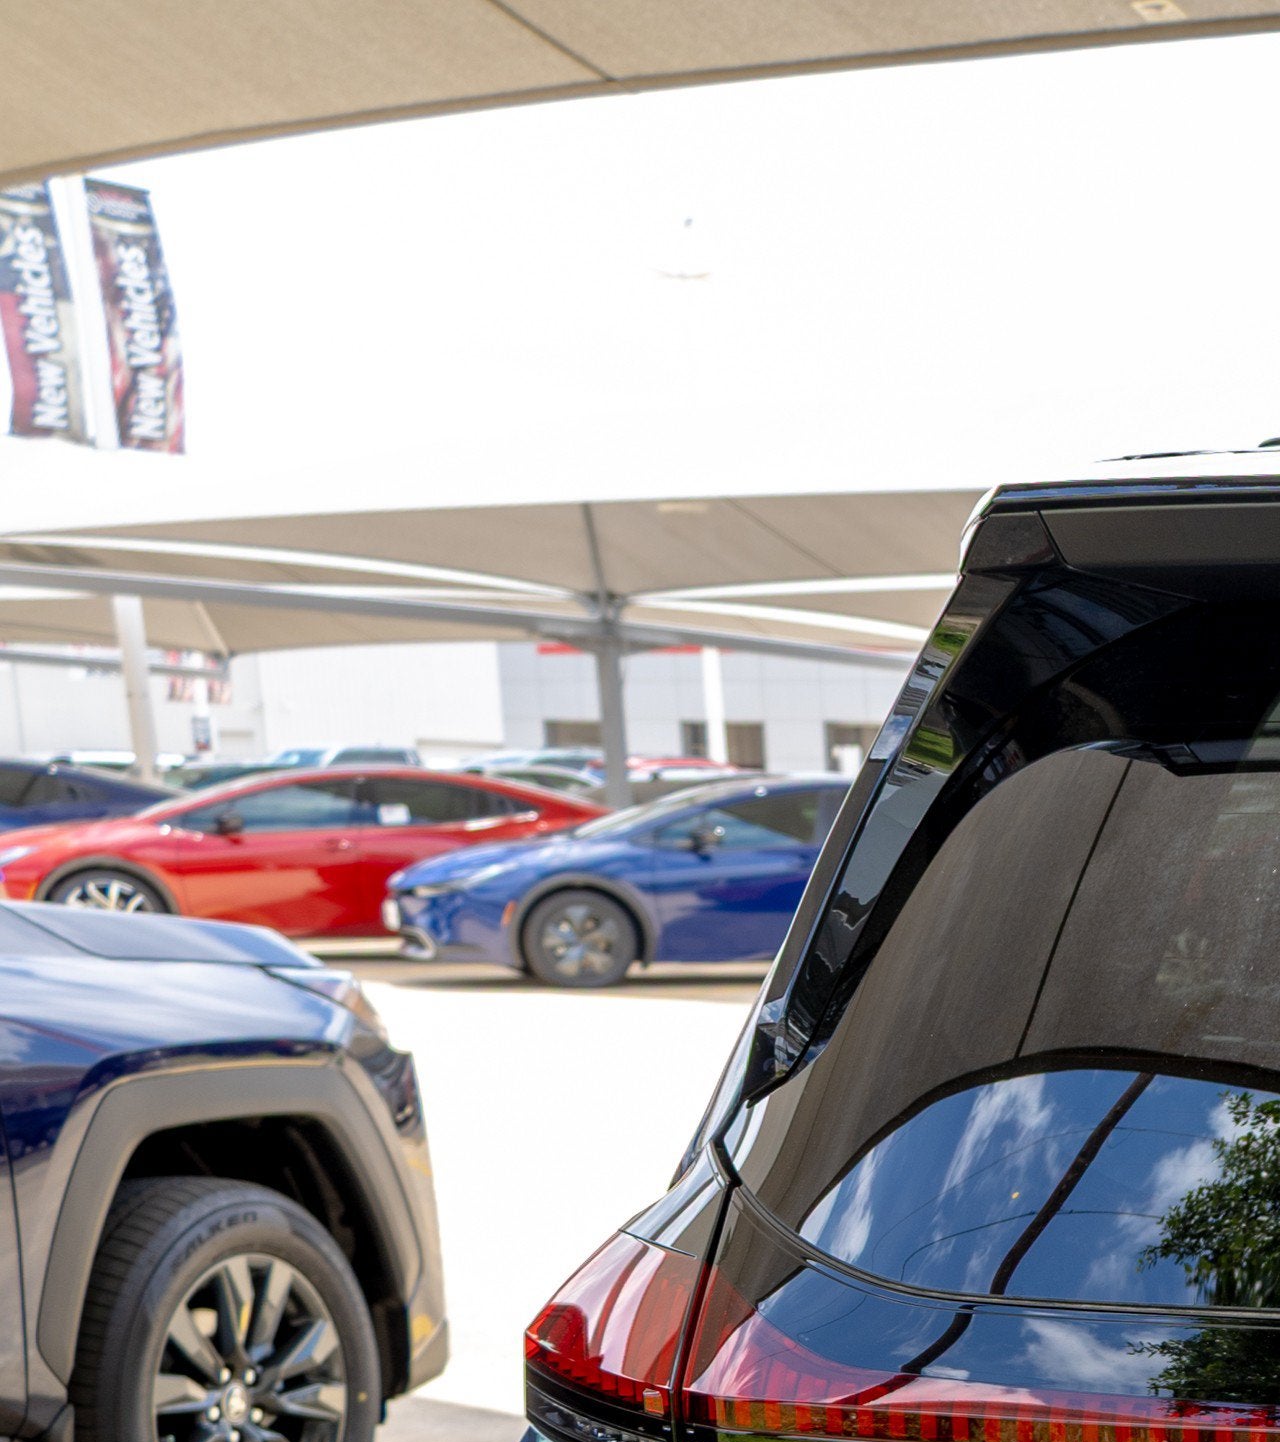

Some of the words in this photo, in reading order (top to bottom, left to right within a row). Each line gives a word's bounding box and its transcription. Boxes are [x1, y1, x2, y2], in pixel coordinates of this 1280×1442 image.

[10, 224, 62, 356] Vehicles
[113, 242, 164, 369] Vehicles
[31, 356, 69, 430] New
[127, 370, 167, 441] New
